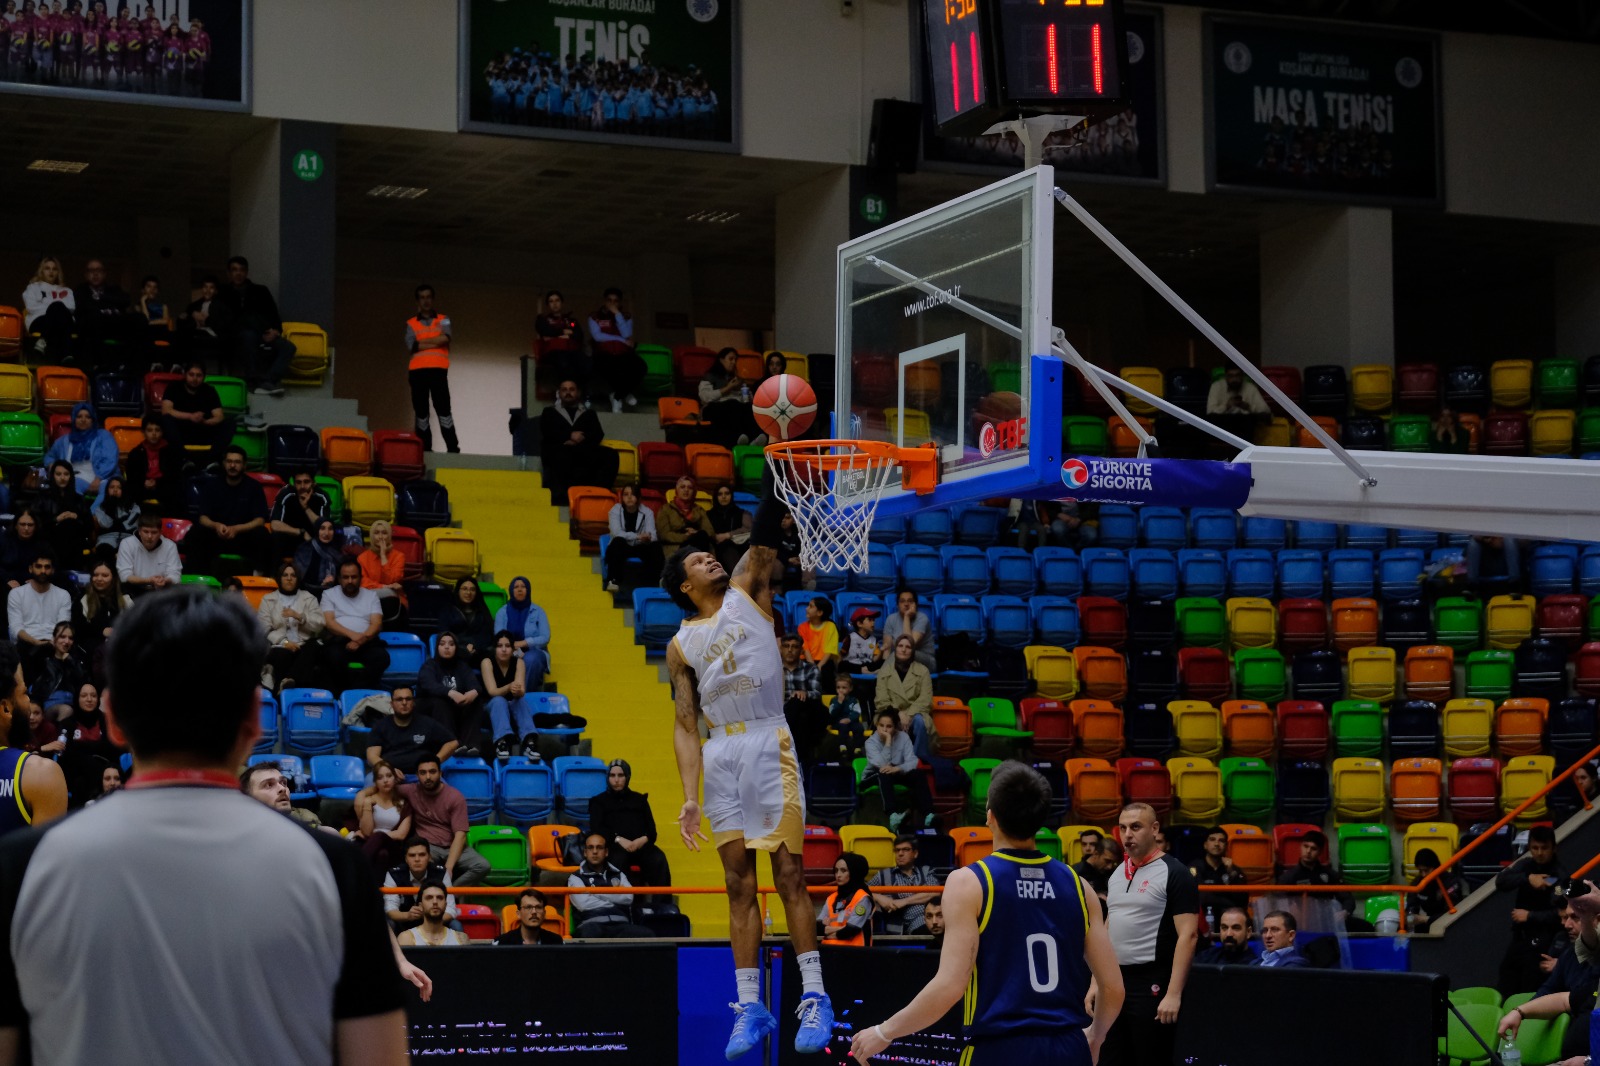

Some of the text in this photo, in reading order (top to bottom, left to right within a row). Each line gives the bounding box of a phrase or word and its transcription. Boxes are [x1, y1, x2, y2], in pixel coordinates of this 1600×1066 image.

[1045, 22, 1104, 95] 11
[1253, 85, 1319, 128] MASA
[297, 153, 317, 170] A1
[866, 198, 883, 214] B1
[996, 417, 1027, 450] TBF
[1090, 460, 1152, 477] TÜRKİYE
[1090, 474, 1153, 491] SİGORTA
[703, 624, 747, 663] KONYA
[1015, 879, 1056, 900] ERFA
[1026, 933, 1059, 993] 0
